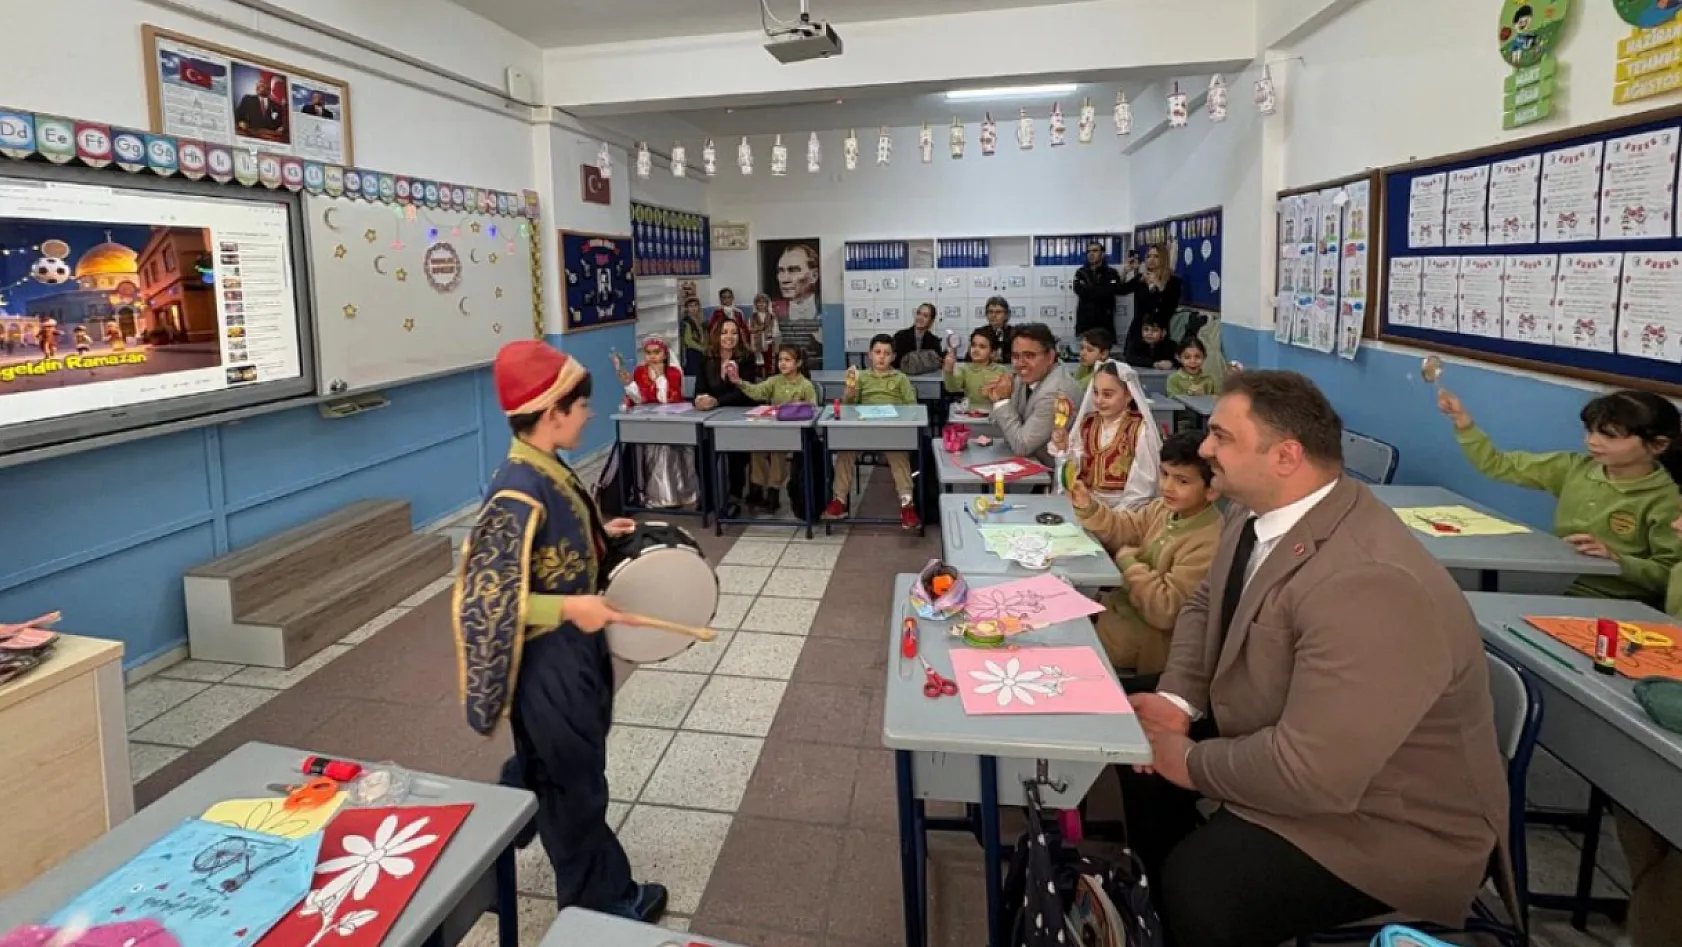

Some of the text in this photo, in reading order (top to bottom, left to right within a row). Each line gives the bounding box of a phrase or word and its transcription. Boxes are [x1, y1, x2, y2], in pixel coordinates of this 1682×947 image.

[0, 120, 28, 139] Dd
[45, 127, 68, 144] Ee
[85, 133, 104, 151] Ff
[118, 138, 141, 158] Gg
[0, 352, 147, 381] geldin Ramazan
